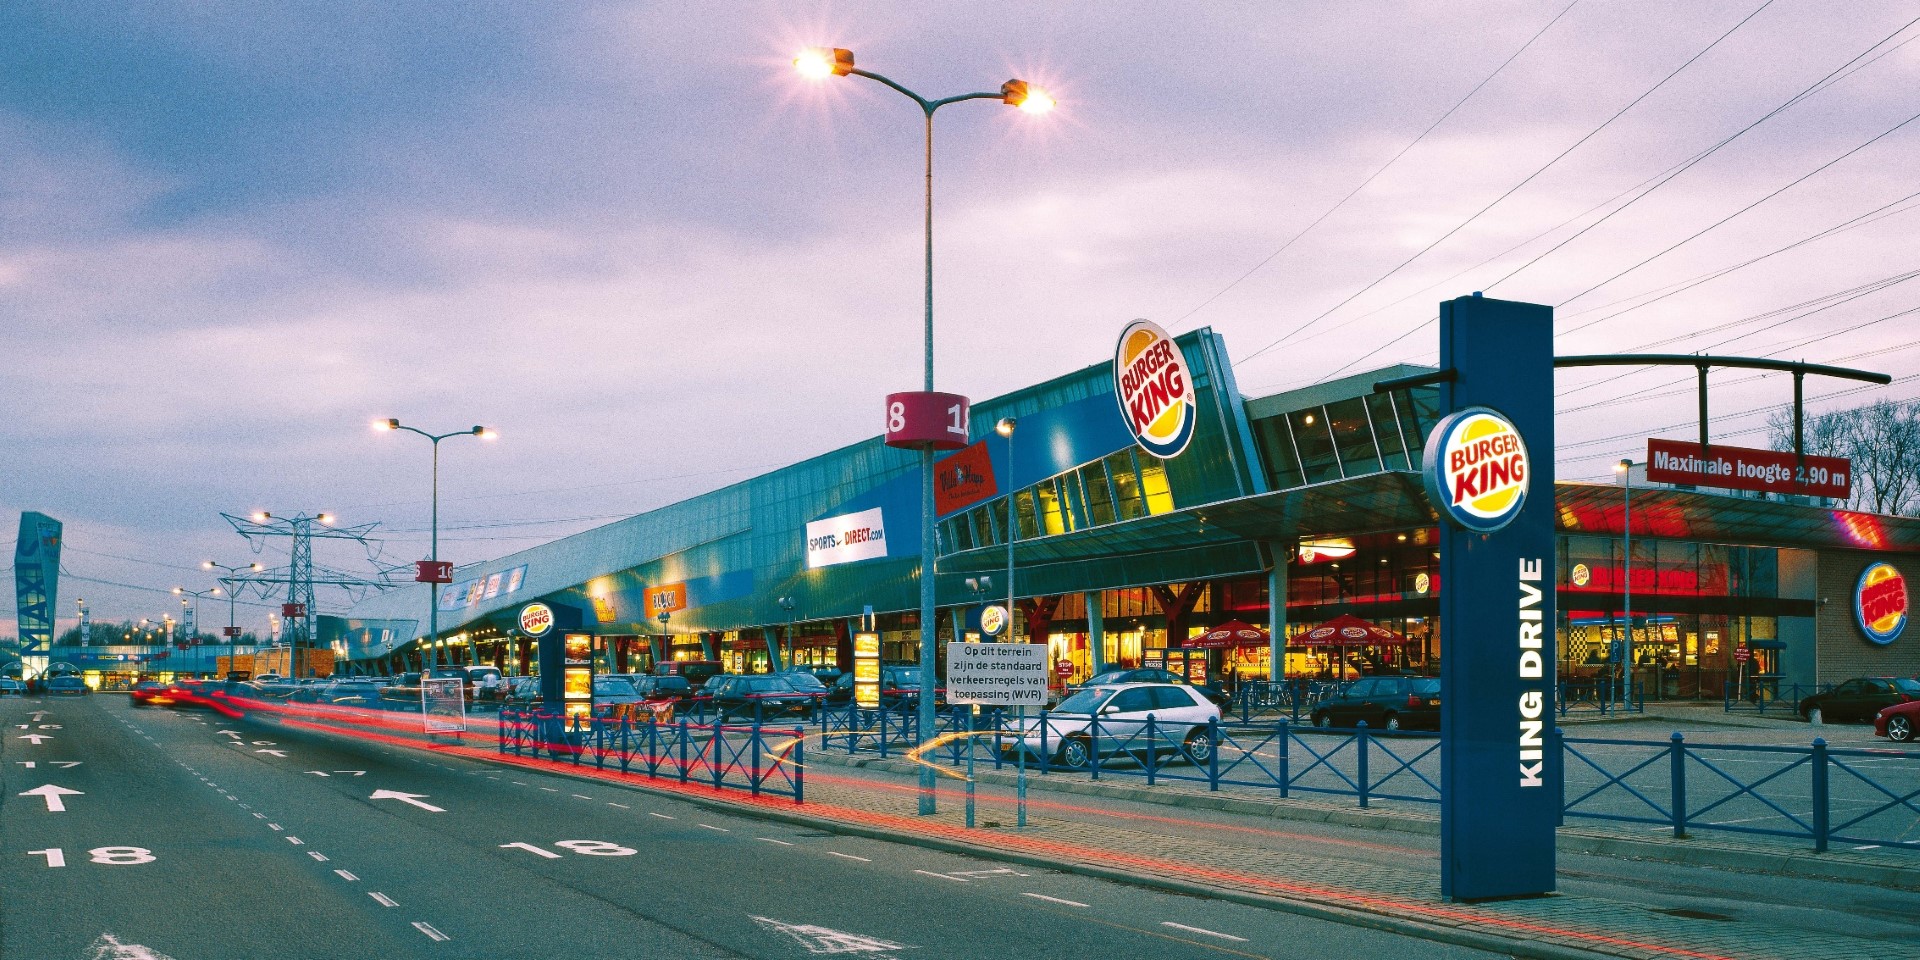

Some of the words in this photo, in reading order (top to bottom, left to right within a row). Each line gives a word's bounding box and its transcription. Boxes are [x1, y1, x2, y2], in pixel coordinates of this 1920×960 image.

[1122, 339, 1174, 402] BURGER
[1130, 362, 1184, 435] KING
[886, 401, 905, 433] 8
[947, 403, 970, 437] 1
[1451, 434, 1519, 473] BURGER
[1654, 451, 1732, 476] Maximale
[1737, 460, 1791, 483] hoogte
[1795, 466, 1828, 486] 2,90
[1832, 472, 1845, 486] m
[1454, 453, 1524, 504] KING
[809, 534, 836, 552] SPORTS
[522, 609, 548, 622] BURGER
[523, 615, 550, 630] KING
[983, 615, 1000, 628] KING
[1519, 557, 1543, 678] DRIVE
[964, 646, 978, 657] Op
[981, 646, 994, 656] dit
[997, 647, 1032, 656] terrein
[1613, 642, 1619, 653] P
[953, 662, 974, 672] zijn
[976, 662, 988, 670] de
[990, 662, 1042, 671] standaard
[950, 675, 1025, 687] verkeersregels
[1027, 677, 1046, 685] van
[954, 690, 1010, 701] toepassing
[1012, 690, 1042, 701] (WVR)
[1519, 691, 1543, 787] KING
[27, 846, 157, 868] 18
[498, 840, 639, 859] 18
